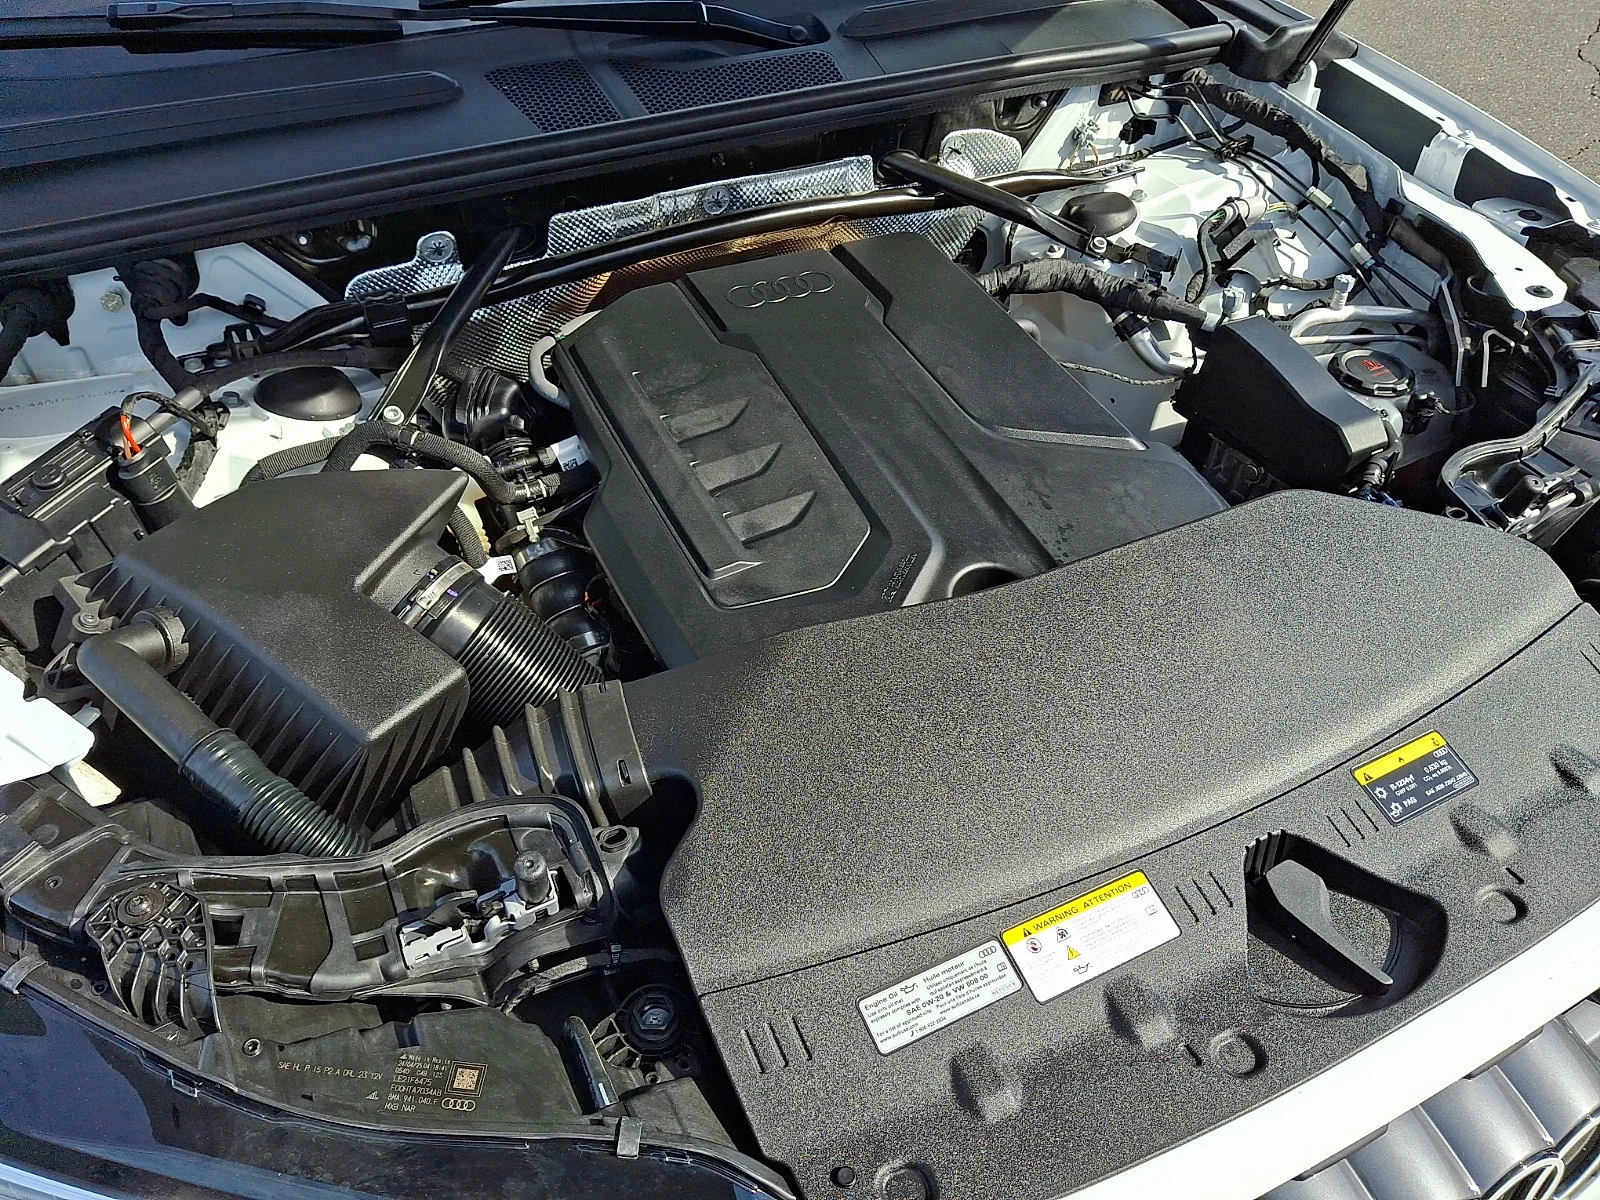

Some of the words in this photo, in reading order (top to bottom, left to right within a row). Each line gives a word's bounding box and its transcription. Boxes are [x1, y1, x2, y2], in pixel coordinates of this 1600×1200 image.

[1437, 758, 1448, 766] kg
[1389, 774, 1414, 791] R-1234yf
[1395, 787, 1406, 796] GWP
[1425, 787, 1435, 796] SAE
[1402, 796, 1417, 807] PAG
[1032, 906, 1078, 930] WARNING
[1083, 882, 1131, 908] ATTENTION
[922, 972, 940, 983] Huile
[940, 961, 964, 975] moteur
[942, 968, 968, 982] uniquement
[937, 981, 954, 992] satisfait
[864, 997, 887, 1010] Engine
[888, 991, 898, 999] Oil
[906, 1004, 921, 1015] SAE
[921, 994, 944, 1008] 0W-20
[951, 983, 964, 993] VW
[965, 977, 978, 987] 508
[935, 1001, 946, 1009] Pour
[870, 1011, 890, 1023] expressly
[891, 1002, 911, 1013] complies
[902, 1012, 922, 1025] approved
[879, 1022, 918, 1043] www.audiusa.com
[431, 1056, 450, 1064] Mexico
[277, 1061, 291, 1069] SAE
[292, 1062, 300, 1071] HL
[323, 1066, 333, 1075] P2
[357, 1070, 368, 1078] 23
[370, 1072, 383, 1080] 12V
[384, 1102, 399, 1110] MXB
[400, 1103, 416, 1112] NAR
